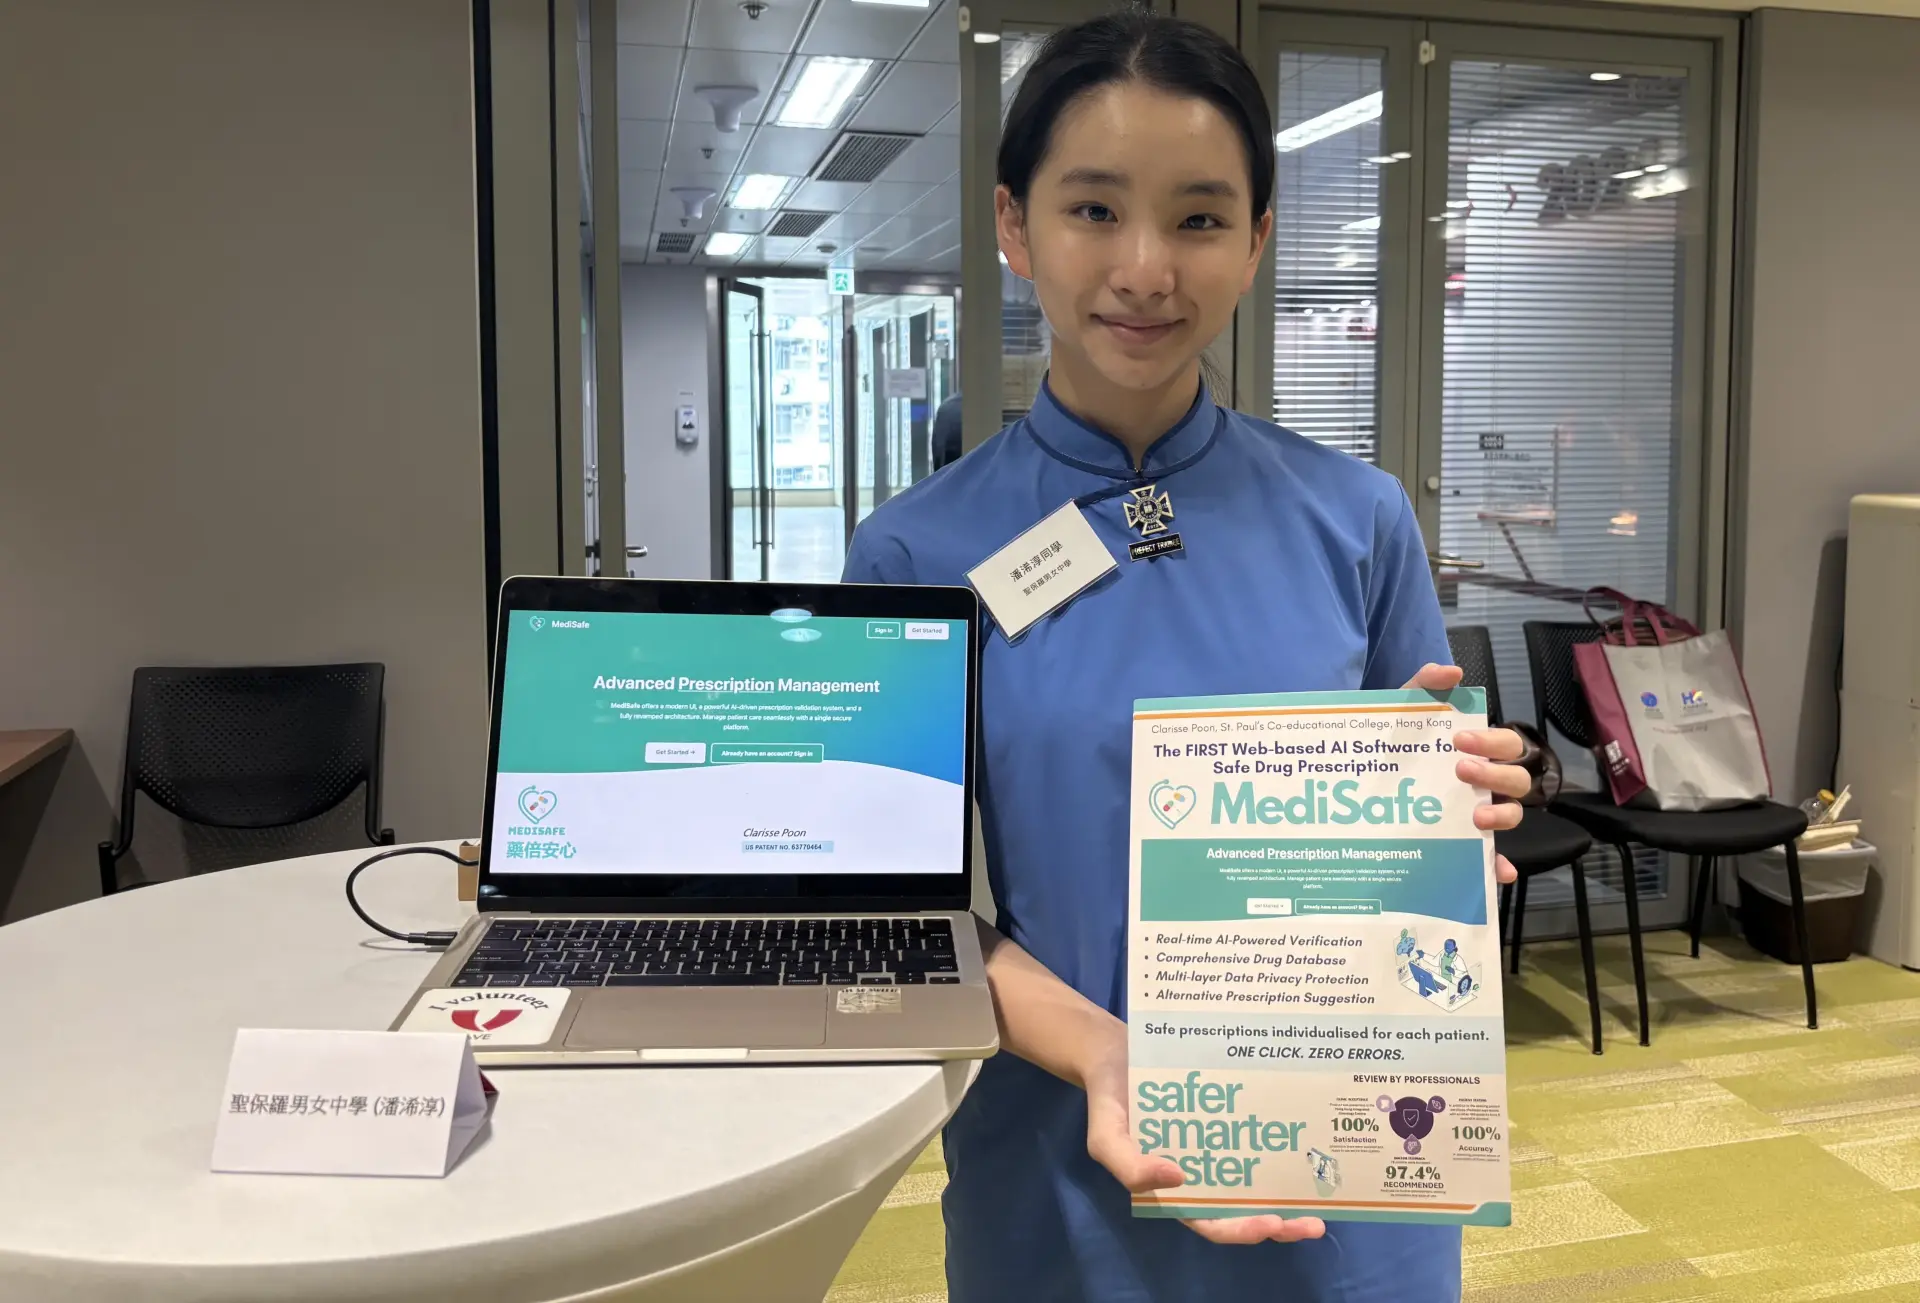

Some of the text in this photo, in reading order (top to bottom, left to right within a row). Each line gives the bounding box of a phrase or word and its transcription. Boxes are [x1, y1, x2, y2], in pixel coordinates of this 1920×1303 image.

[1009, 540, 1063, 582] 潘浠淳同學
[1022, 558, 1072, 596] 聖保羅男女中學
[551, 619, 590, 630] MediSafe
[593, 675, 880, 695] Advanced Prescription Management
[703, 703, 730, 711] powerful
[758, 704, 793, 712] prescription
[633, 713, 664, 721] revamped
[763, 714, 795, 722] seamlessly
[1151, 724, 1189, 734] Clarisse
[1191, 723, 1218, 733] Poon,
[1220, 723, 1233, 732] St.
[1267, 719, 1346, 730] Co-educational
[1349, 719, 1393, 731] College,
[1396, 719, 1423, 729] Hong
[1426, 718, 1452, 729] Kong
[1154, 744, 1181, 757] The
[1186, 743, 1228, 757] FIRST
[1232, 741, 1326, 756] Web-based
[1331, 741, 1347, 754] AI
[1352, 739, 1430, 754] Software
[1213, 759, 1399, 777] Safe Drug Prescription
[1210, 778, 1442, 825] MediSafe
[508, 826, 566, 836] MEDISAFE
[743, 828, 807, 837] Clarisse Poon
[506, 841, 577, 859] 藥倍安心
[1206, 848, 1422, 861] Advanced Prescription Management
[1156, 933, 1363, 947] Real-time AI-Powered Verification
[1156, 952, 1346, 967] Comprehensive Drug Database
[1155, 970, 1369, 987] Multi-layer Data Privacy Protection
[445, 992, 549, 1010] volunteer
[1155, 989, 1375, 1006] Alternative Prescription Suggestion
[1145, 1022, 1489, 1043] Safe prescriptions individualised for each patient.
[1227, 1046, 1405, 1060] ONE CLICK. ZERO ERRORS.
[1353, 1074, 1481, 1085] REVIEW BY PROFESSIONALS
[1137, 1070, 1243, 1114] safer
[229, 1094, 445, 1117] 聖保羅男女中學 (潘浠淳)
[1331, 1117, 1380, 1132] 100%
[1138, 1114, 1307, 1151] smarter
[1333, 1135, 1377, 1143] Satisfaction
[1452, 1125, 1501, 1140] 100%
[1458, 1145, 1494, 1153] Accuracy
[1141, 1144, 1261, 1187] ster
[1385, 1165, 1441, 1180] 97.4%
[1383, 1181, 1444, 1189] RECOMMENDED
